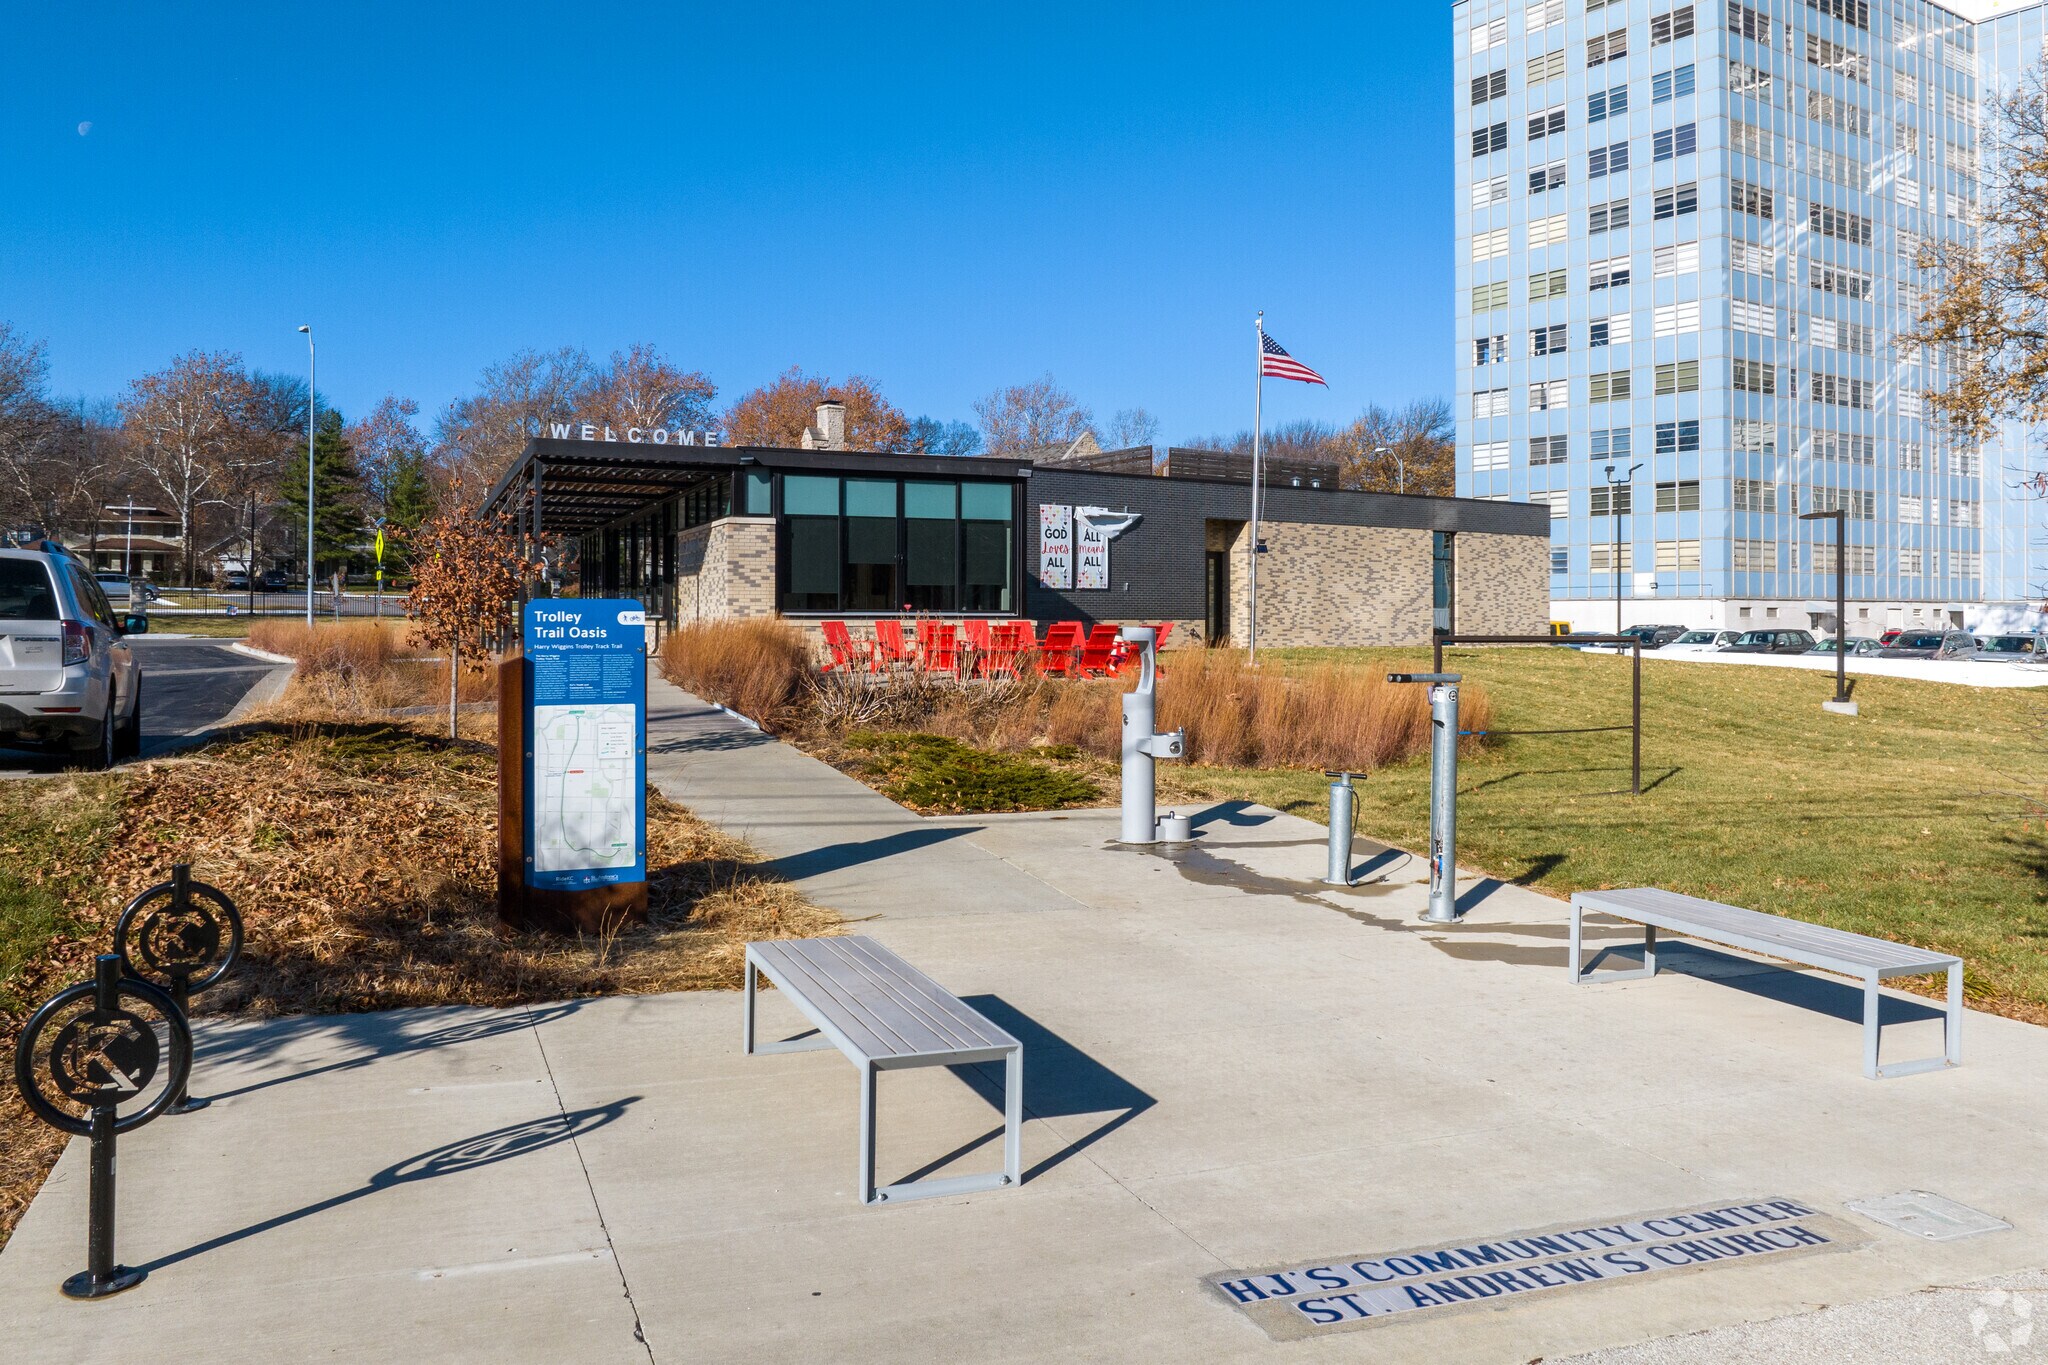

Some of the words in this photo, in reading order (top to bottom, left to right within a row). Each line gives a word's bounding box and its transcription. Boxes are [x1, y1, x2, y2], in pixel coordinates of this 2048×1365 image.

[550, 424, 718, 448] WELCOME
[1044, 528, 1068, 540] GOD
[1083, 531, 1101, 542] ALL
[1042, 542, 1069, 555] Loves
[1047, 557, 1065, 568] ALL
[1083, 556, 1101, 567] ALL
[534, 611, 582, 625] Trolley
[534, 627, 564, 638] Trail
[569, 627, 607, 638] Oasis
[1220, 1266, 1351, 1303] HJ'S
[1351, 1225, 1644, 1282] COMMUNITY
[1642, 1200, 1815, 1238] CENTER
[1297, 1293, 1393, 1325] ST.
[1404, 1250, 1650, 1309] ANDREW'S
[1646, 1225, 1831, 1266] CHURCH
